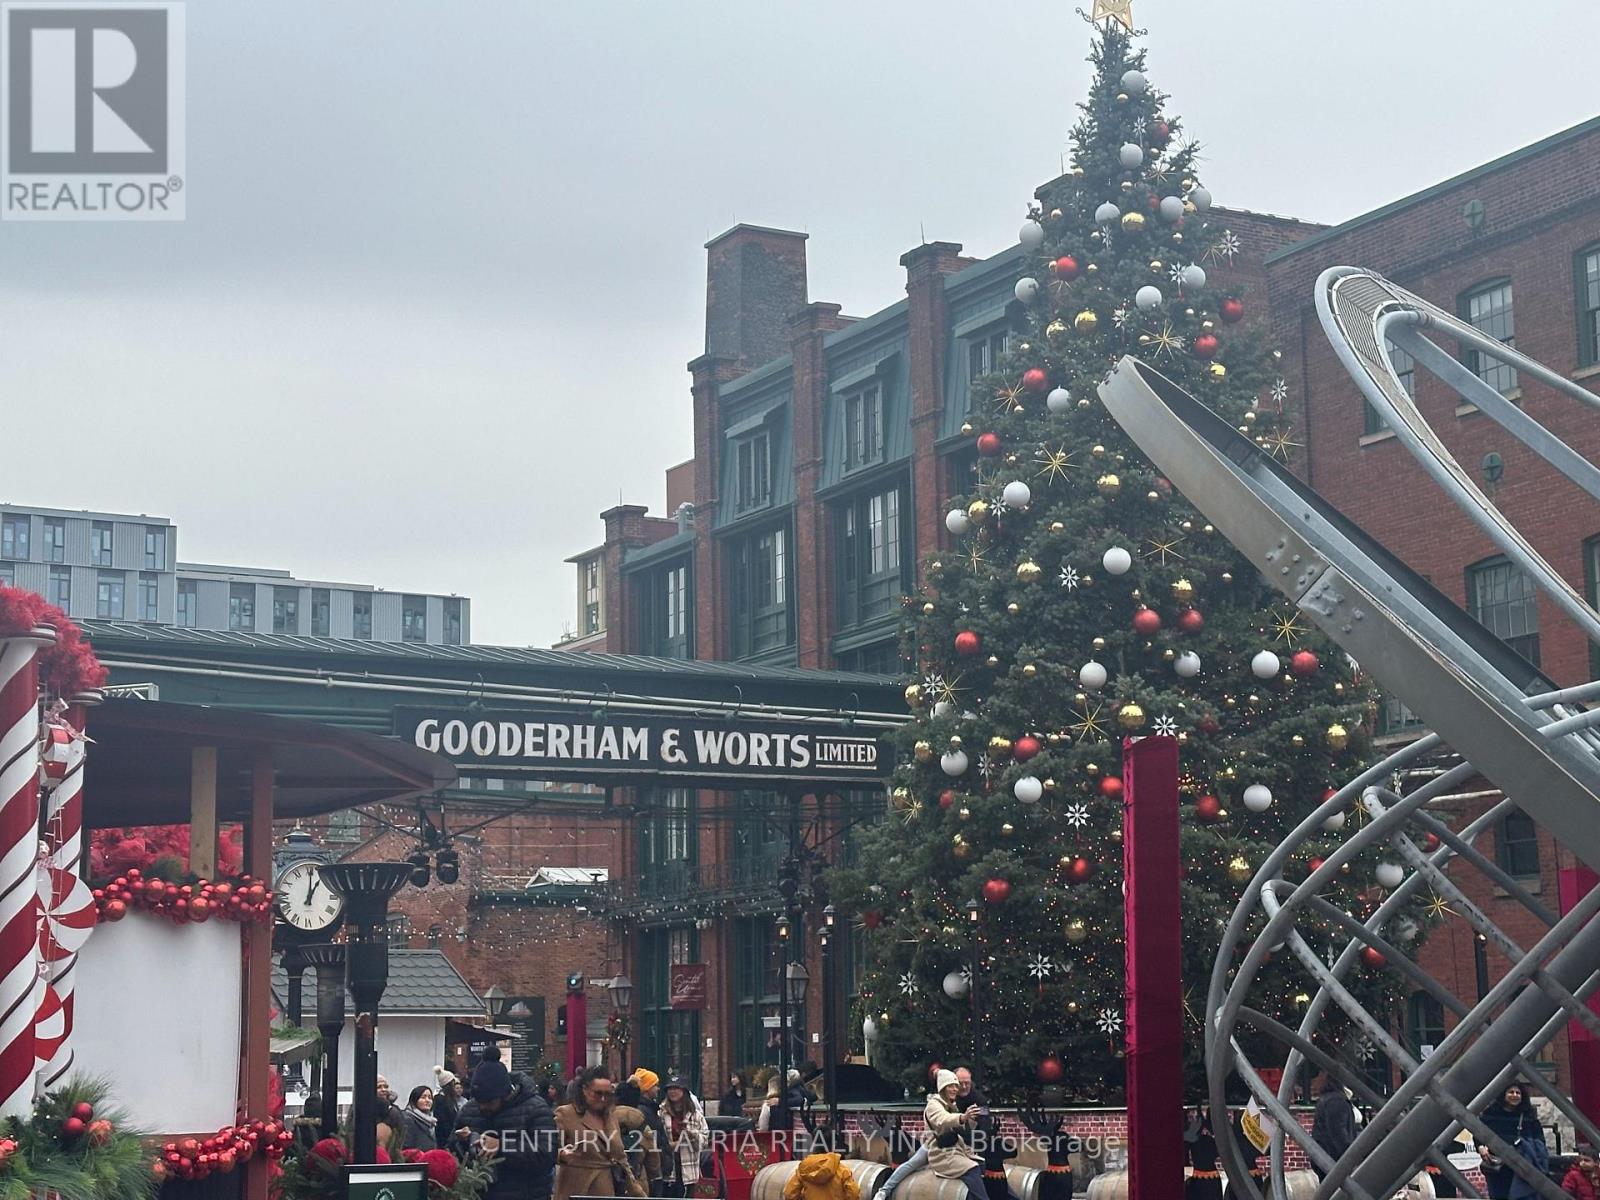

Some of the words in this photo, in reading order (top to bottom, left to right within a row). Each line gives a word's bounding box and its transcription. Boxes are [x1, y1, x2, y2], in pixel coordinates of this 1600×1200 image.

[415, 719, 649, 761] GOODERHAM
[660, 728, 688, 764] &
[694, 730, 810, 768] WORTS
[815, 742, 877, 763] LIMITED
